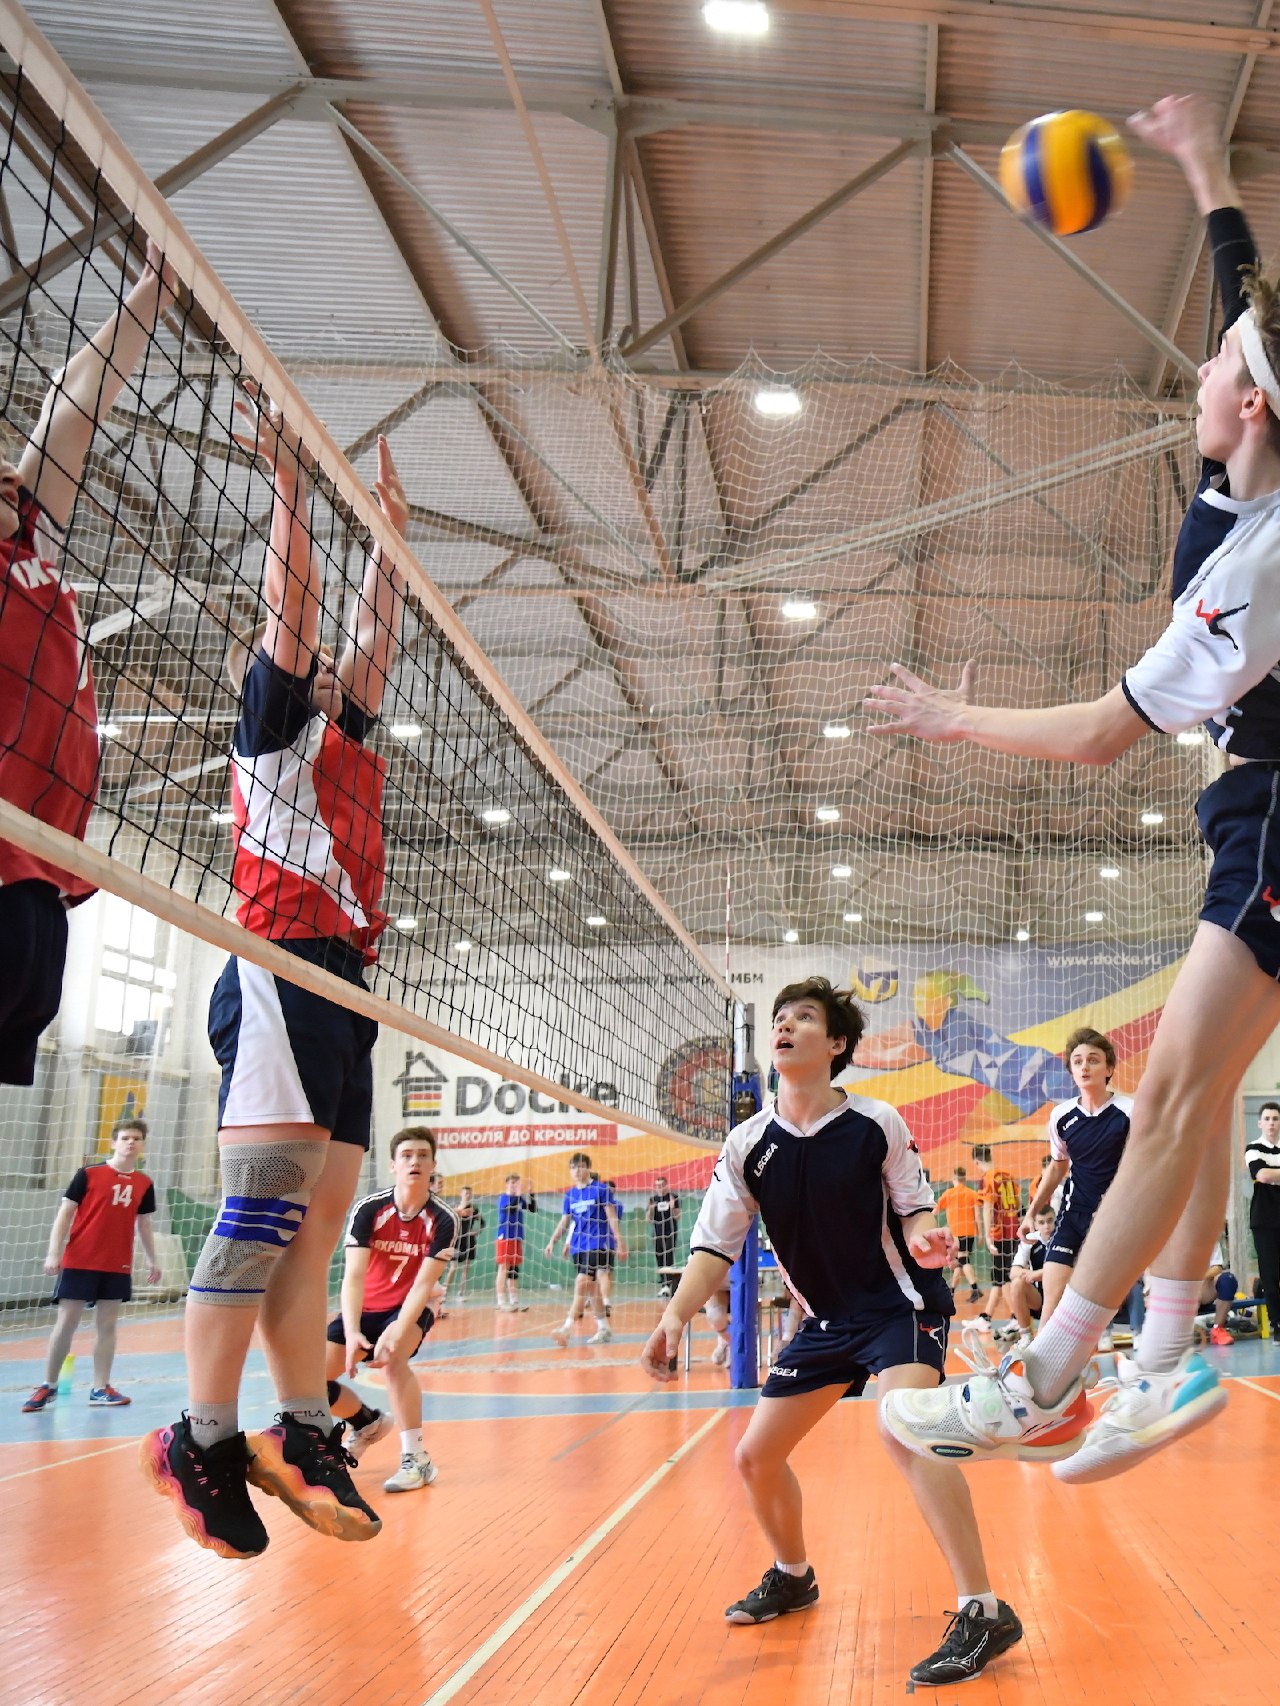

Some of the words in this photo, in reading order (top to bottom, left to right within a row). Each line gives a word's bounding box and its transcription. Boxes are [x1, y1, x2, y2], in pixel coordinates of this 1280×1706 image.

[437, 1130, 504, 1145] ЦОКОЛЯ
[508, 1129, 531, 1143] ДО
[535, 1128, 598, 1142] КРОВЛИ
[754, 1142, 778, 1177] LEGEA
[112, 1184, 133, 1207] 14
[389, 1255, 409, 1284] 7
